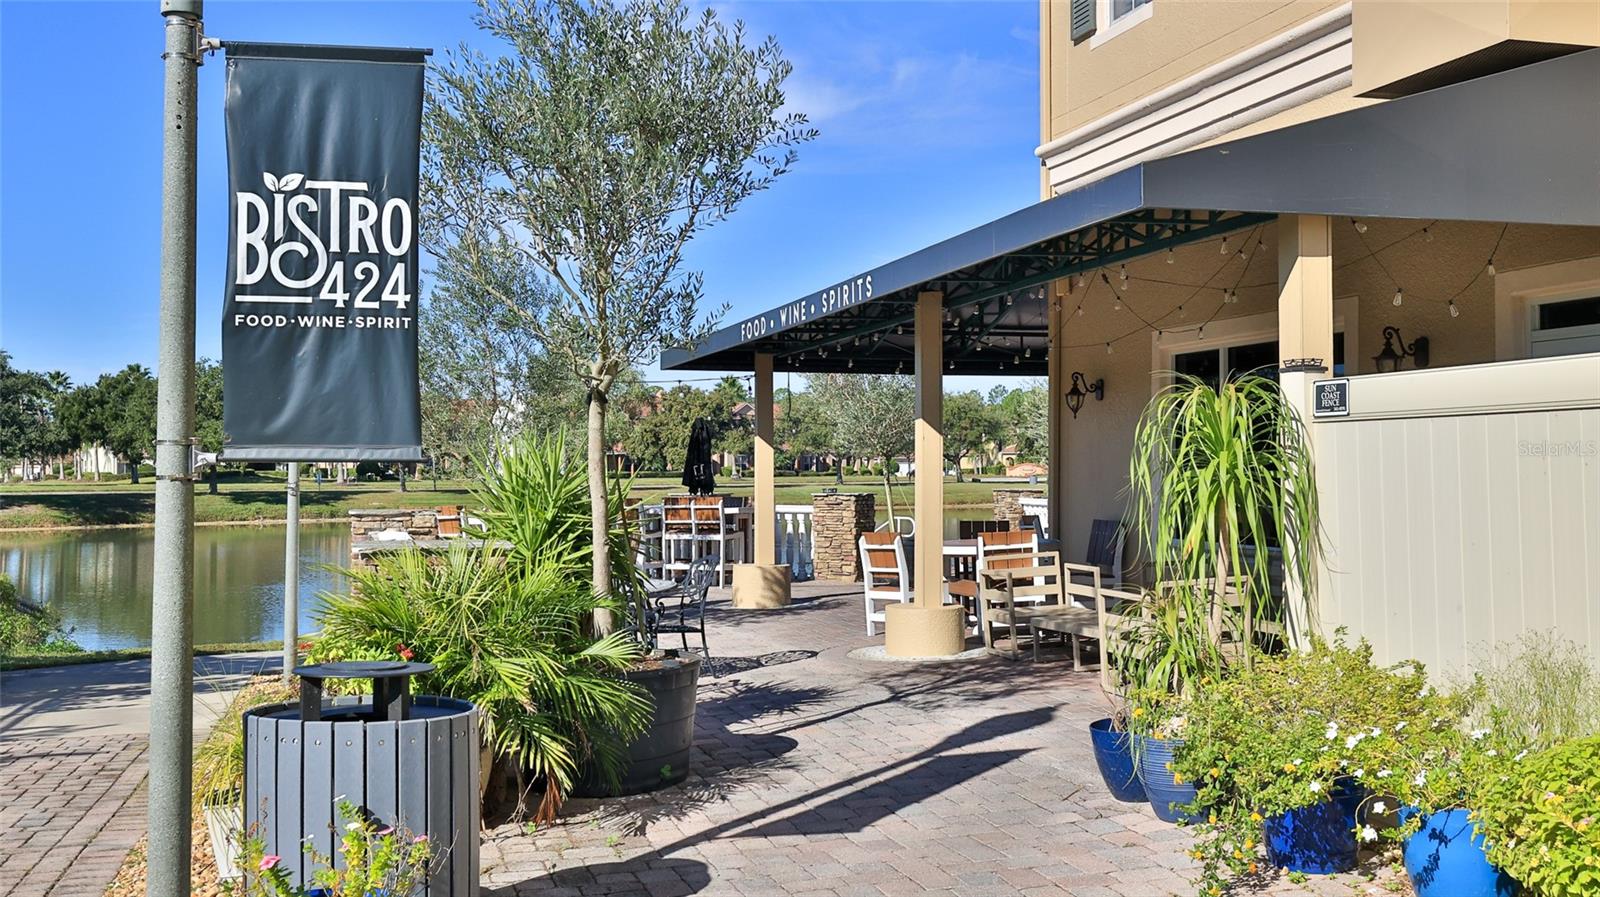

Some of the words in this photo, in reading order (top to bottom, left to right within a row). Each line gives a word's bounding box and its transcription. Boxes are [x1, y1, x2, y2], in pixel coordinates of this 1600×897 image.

[235, 180, 412, 289] BISTRO
[319, 261, 411, 309] 424
[741, 317, 767, 341] FOOD
[780, 300, 807, 327] WINE
[822, 275, 872, 313] SPIRITS
[235, 315, 287, 327] FOOD
[298, 316, 345, 328] WINE
[355, 317, 411, 329] SPIRIT
[1324, 384, 1337, 392] SUN
[1320, 391, 1340, 400] COAST
[1321, 399, 1340, 407] FENCE
